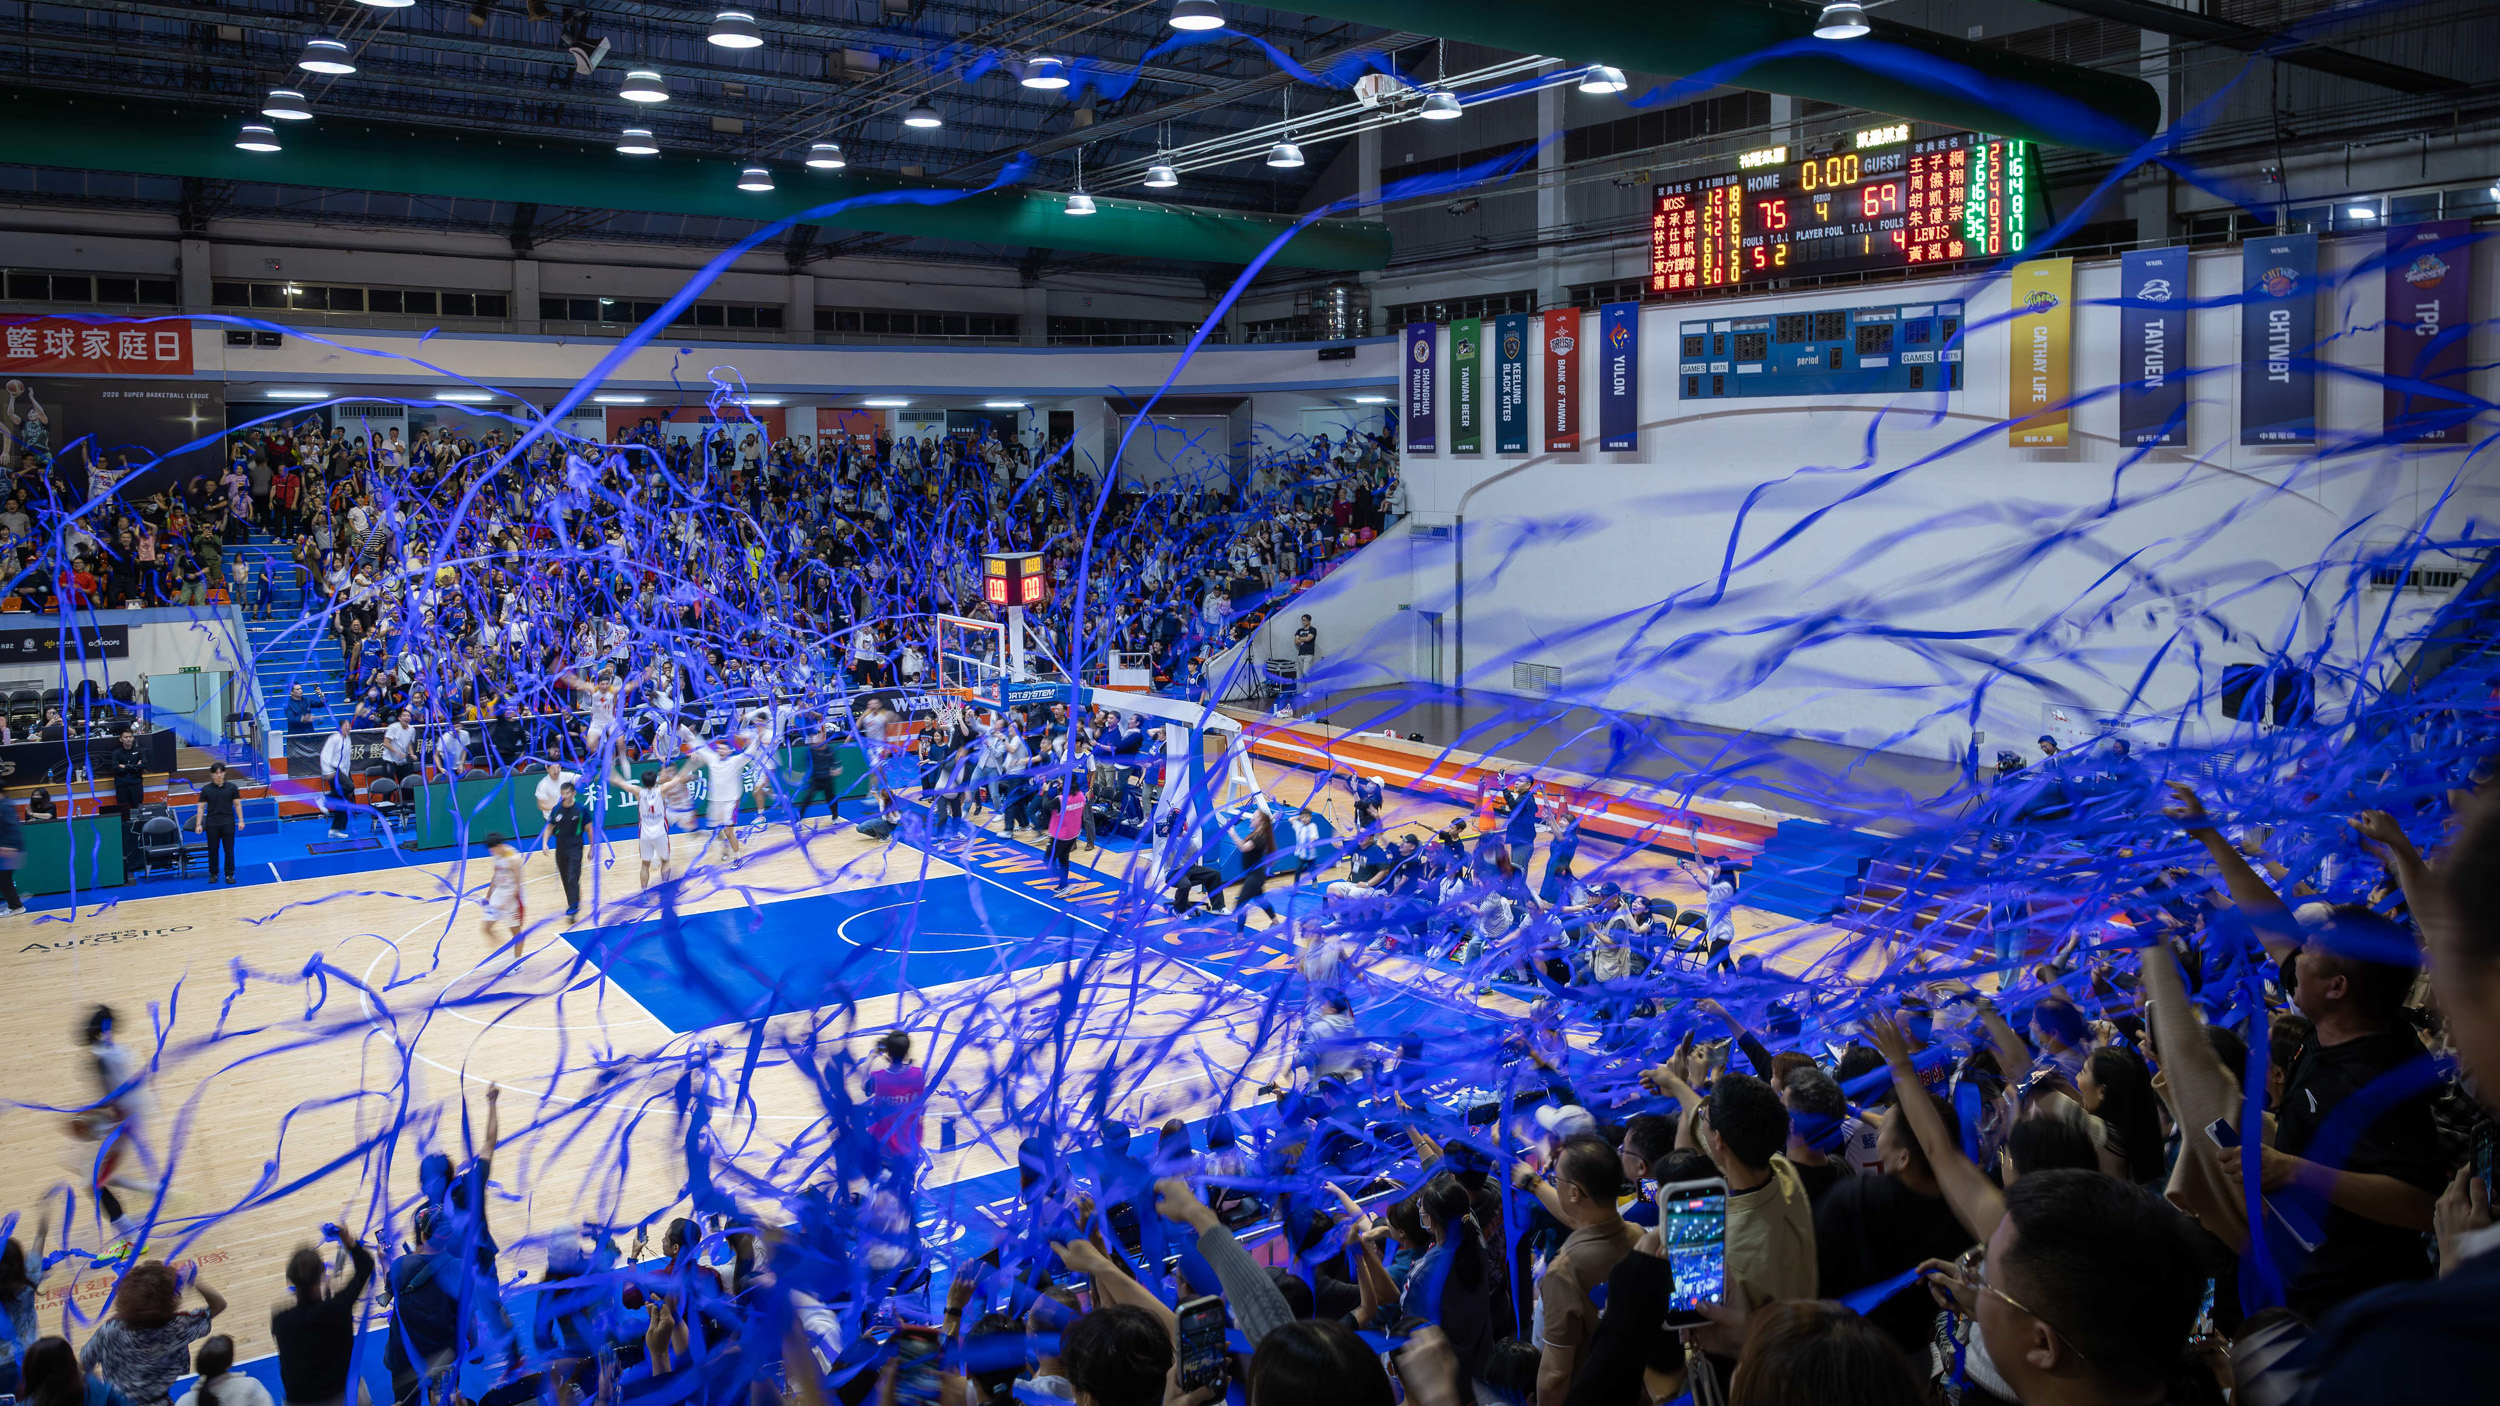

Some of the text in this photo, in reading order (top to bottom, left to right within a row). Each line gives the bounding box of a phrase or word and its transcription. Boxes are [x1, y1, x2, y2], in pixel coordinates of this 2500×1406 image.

[1864, 154, 1900, 173] GUEST
[1976, 146, 1986, 164] 3
[1990, 144, 1999, 161] 2
[2009, 140, 2023, 157] 11
[1975, 164, 1985, 182] 6
[1990, 162, 1999, 179] 2
[2009, 158, 2023, 177] 16
[1747, 174, 1779, 192] HOME
[1972, 182, 1985, 200] 16
[1990, 181, 1999, 196] 4
[2009, 178, 2023, 195] 14
[1663, 186, 1740, 211] MOSS 1 2 18
[1759, 184, 1896, 228] 75 4 69
[1813, 193, 1831, 203] PERIOD
[1966, 201, 1985, 220] 24
[1990, 198, 1999, 216] 0
[2012, 195, 2023, 213] 8
[1704, 206, 1711, 222] 2
[1714, 205, 1722, 219] 4
[1729, 203, 1740, 218] 19
[1654, 218, 1739, 244] 林仕軒 4 2 6
[1742, 217, 1904, 248] FOULS T.O.L PLAYER FOUL T.O.L FOULS
[1914, 214, 2023, 242] LEWIS 35 3 17
[1704, 238, 1711, 253] 6
[1718, 237, 1722, 251] 1
[1731, 235, 1739, 249] 4
[1754, 230, 1905, 267] 5 2 1 4
[1976, 237, 1985, 254] 7
[1990, 235, 1999, 253] 0
[2012, 232, 2022, 251] 0
[1704, 254, 1711, 269] 8
[1718, 253, 1722, 266] 1
[1731, 250, 1739, 265] 5
[1704, 269, 1711, 285] 5
[1714, 268, 1722, 283] 0
[1731, 266, 1739, 282] 0
[2415, 299, 2439, 336] TPC
[6, 326, 180, 360] 籃球家庭日
[1550, 337, 1574, 350] TRUST
[2144, 318, 2164, 387] TAIYUEN
[2268, 310, 2290, 383] CHTWBT
[1682, 363, 1726, 373] GAMES SETS
[1797, 355, 1819, 367] period
[1903, 351, 1959, 362] GAMES SETS
[2032, 326, 2048, 402] CATHAY LIFE
[1461, 366, 1470, 401] TAIWAN
[1512, 362, 1521, 404] KEELUNG
[1613, 355, 1625, 395] YULON
[1413, 368, 1421, 418] PAUIAN BLL
[1422, 368, 1430, 416] CHANGHUA
[1502, 363, 1511, 421] BLACK KITES
[1557, 359, 1566, 431] BANK OF TAIWAN
[1461, 403, 1470, 427] BEER
[19, 925, 193, 953] Aurastro
